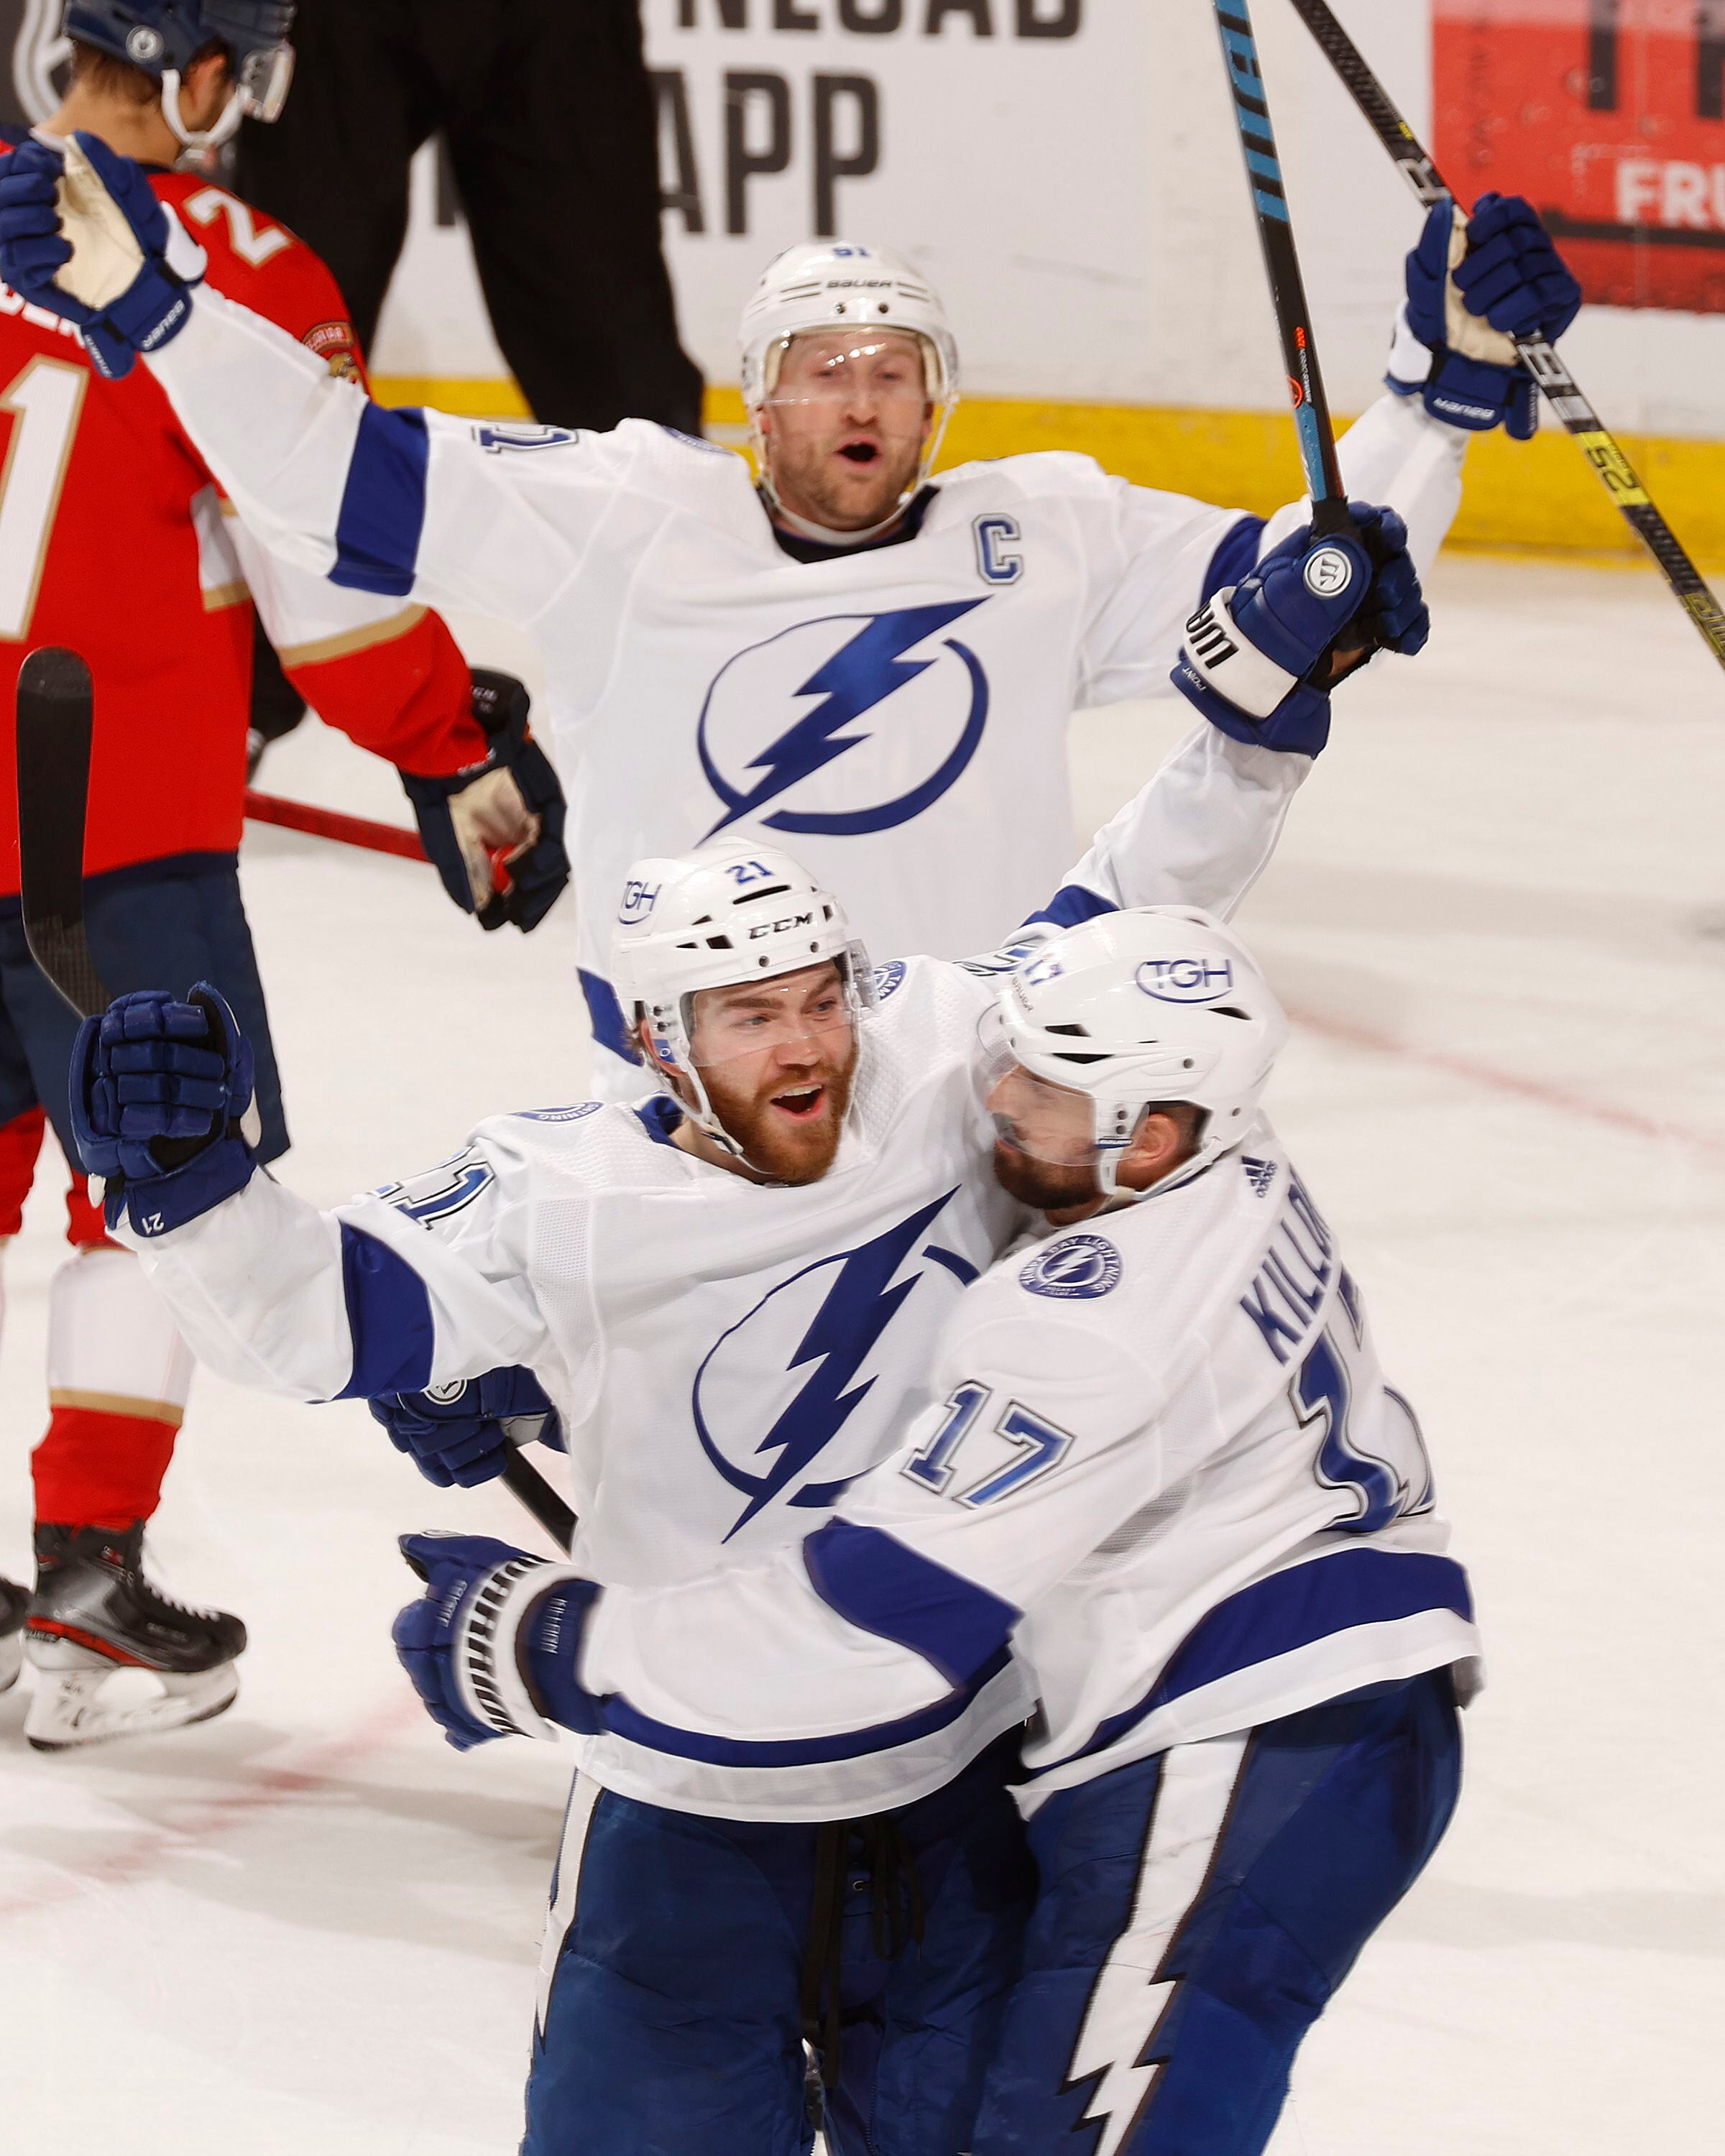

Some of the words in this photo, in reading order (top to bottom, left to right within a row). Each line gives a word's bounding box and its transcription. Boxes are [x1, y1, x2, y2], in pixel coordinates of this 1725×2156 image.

[650, 67, 881, 236] APP
[183, 185, 292, 271] 2
[827, 279, 893, 289] BAUER
[1432, 396, 1497, 422] BAUER
[971, 512, 1024, 586] C
[1181, 666, 1208, 692] POINT
[727, 860, 776, 886] 21
[748, 911, 814, 940] CCM
[1146, 959, 1234, 990] TGH
[141, 1212, 165, 1235] 21
[1086, 1236, 1121, 1294] LIGHTNING
[899, 1378, 1078, 1510] 17
